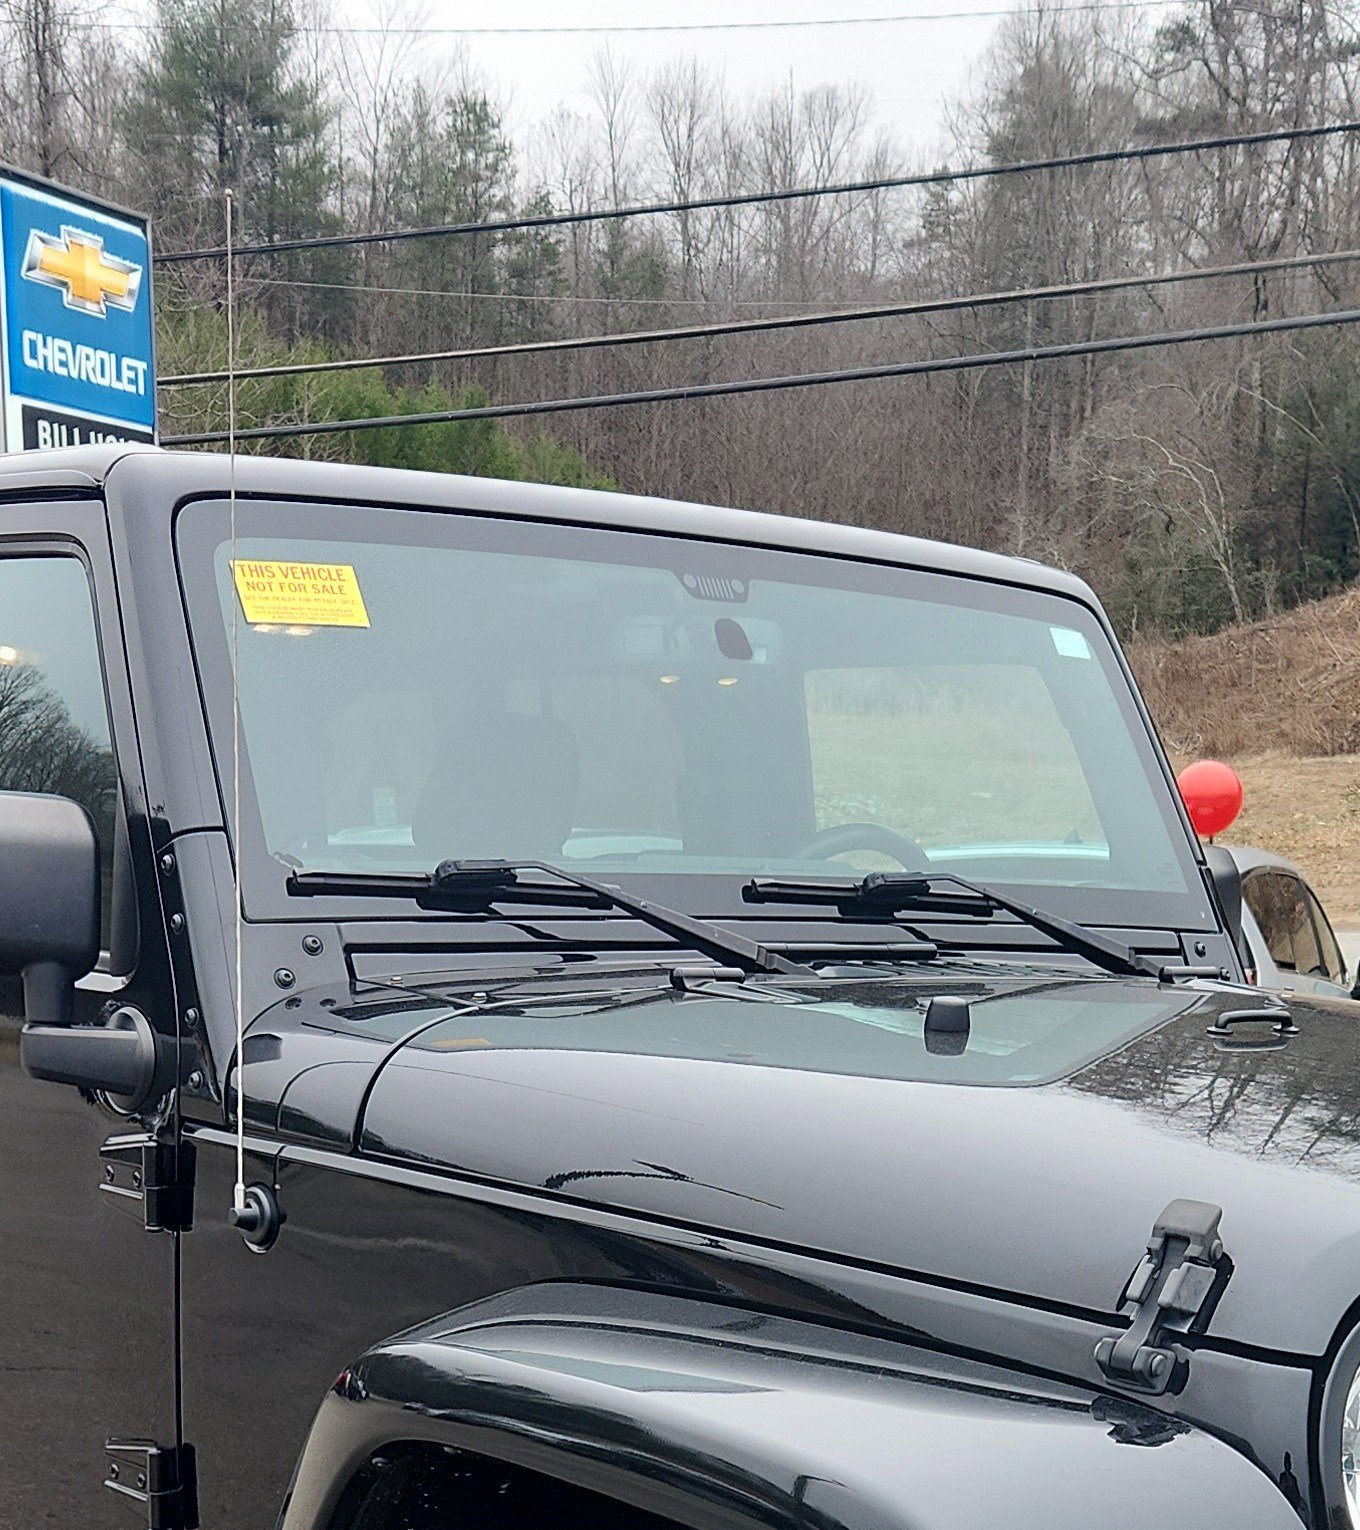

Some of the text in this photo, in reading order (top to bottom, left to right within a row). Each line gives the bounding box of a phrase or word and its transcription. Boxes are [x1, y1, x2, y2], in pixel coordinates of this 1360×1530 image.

[22, 329, 147, 396] CHEVROLET
[237, 564, 346, 582] THIS VEHICLE
[246, 581, 347, 595] NOT FOR SALE
